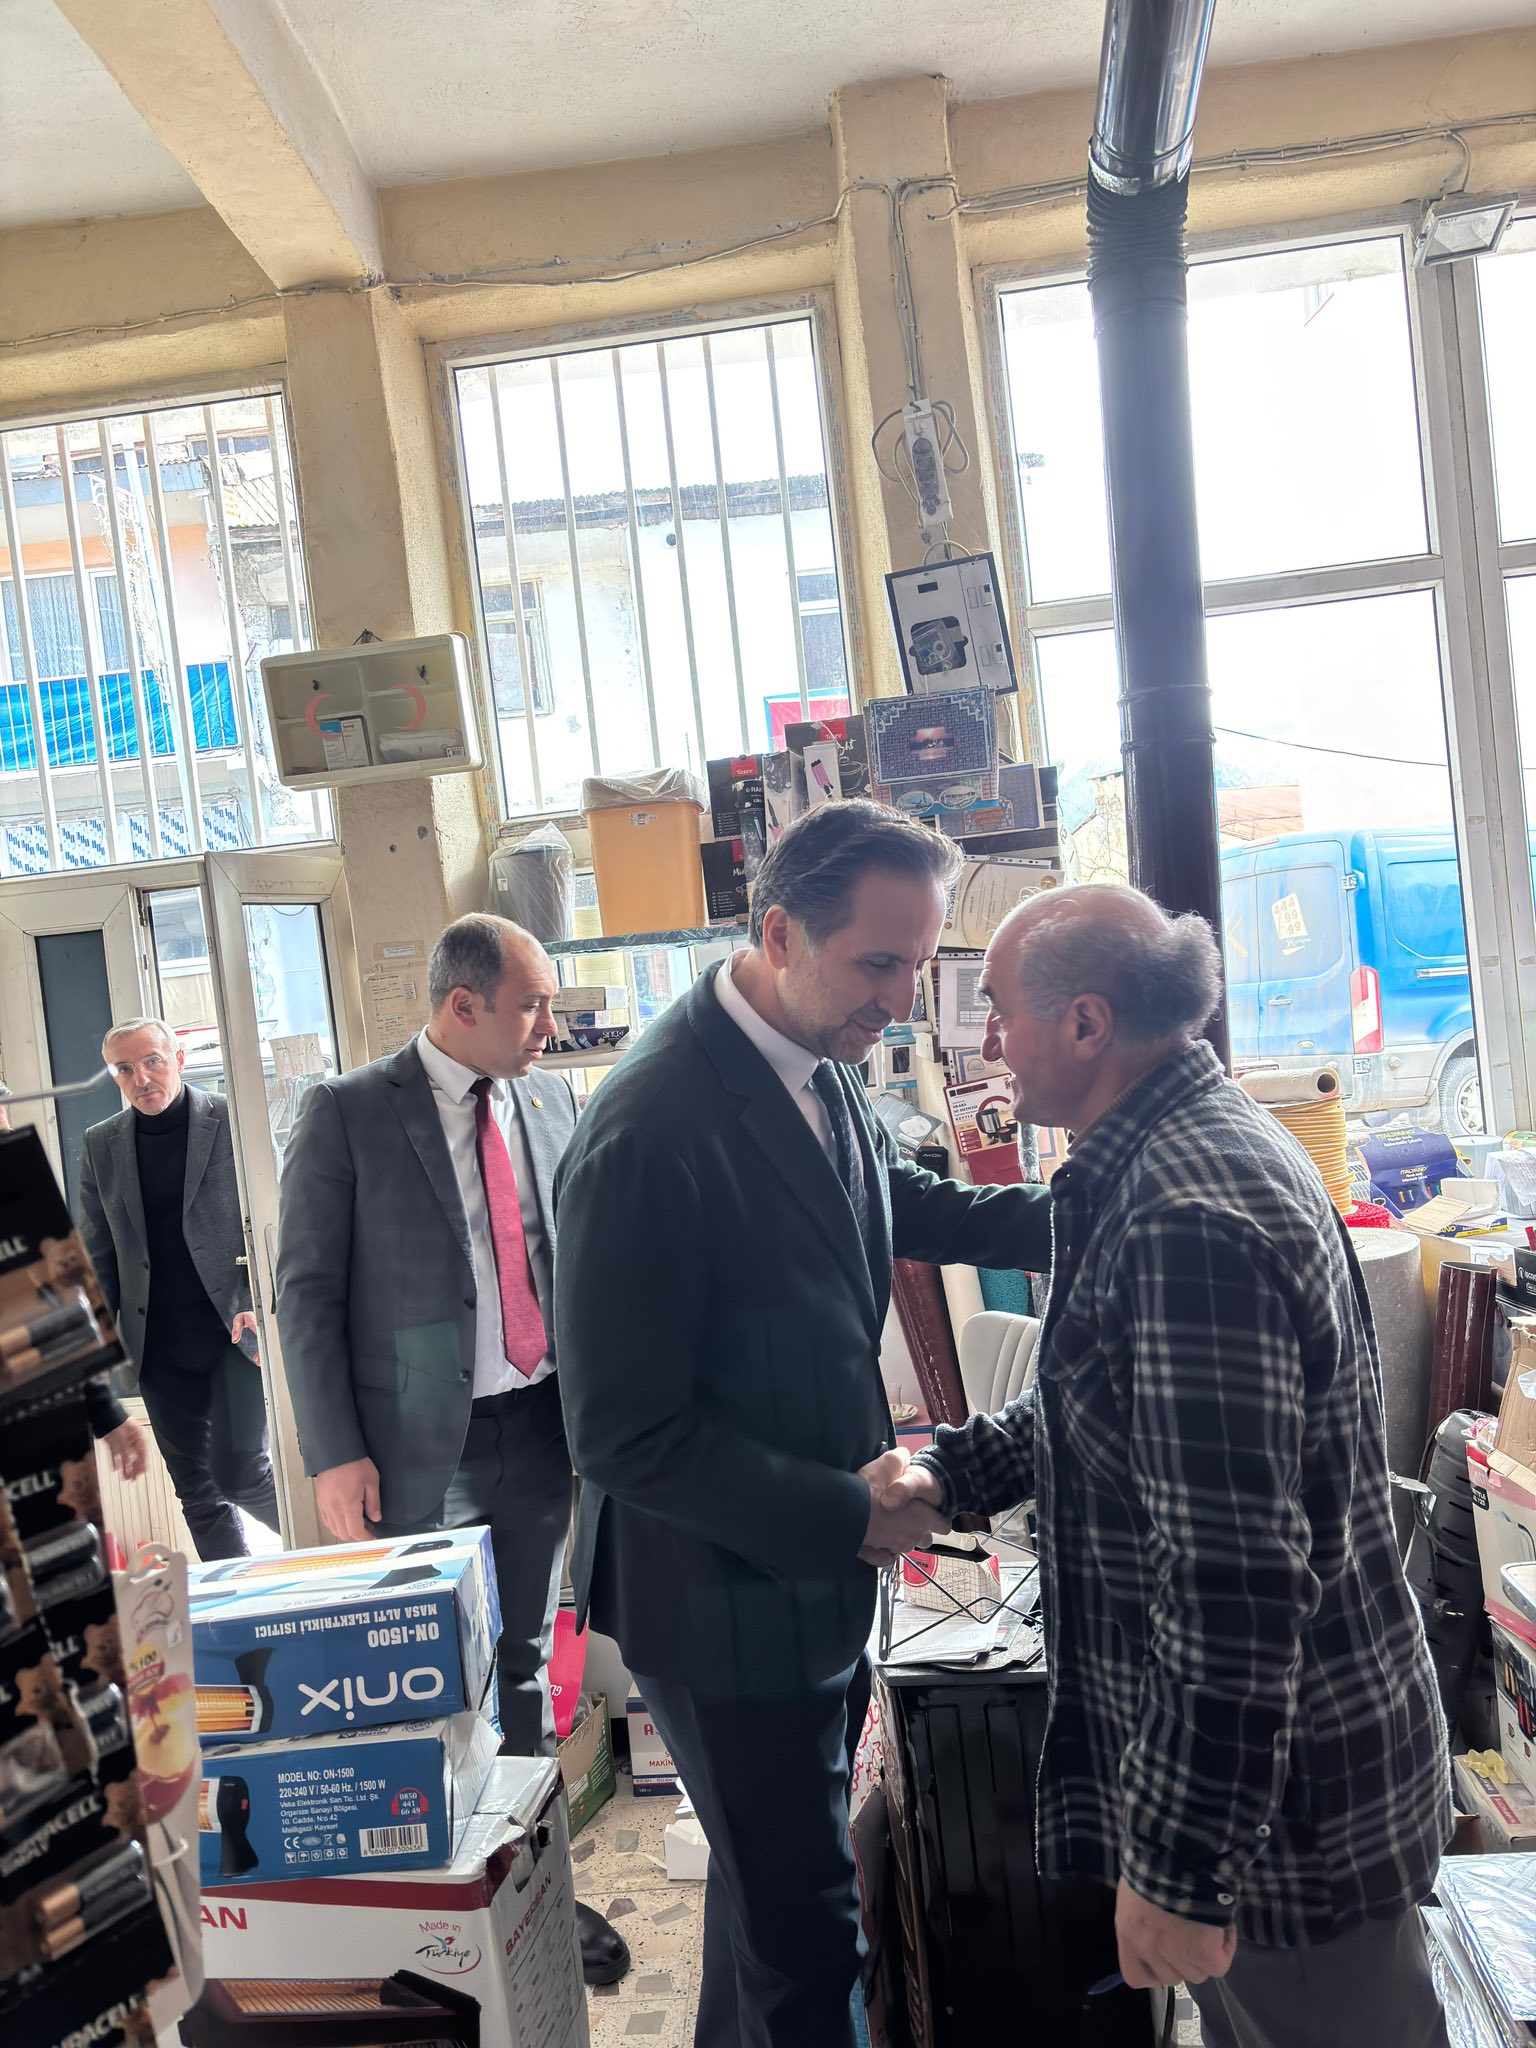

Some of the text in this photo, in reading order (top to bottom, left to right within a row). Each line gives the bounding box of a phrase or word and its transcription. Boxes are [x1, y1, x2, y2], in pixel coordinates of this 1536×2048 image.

[1273, 897, 1295, 915] 444
[1284, 909, 1298, 923] 99
[1287, 921, 1301, 935] 99
[938, 1568, 970, 1581] CAMERA
[255, 1603, 438, 1638] MASA ALTI ELEKTRİKLİ ISITICI
[367, 1622, 440, 1648] ON-1500
[298, 1666, 445, 1721] onix
[278, 1767, 355, 1784] MODEL NO: ON-1500
[279, 1786, 307, 1798] 220-240
[309, 1785, 315, 1795] V
[320, 1784, 340, 1795] 50-60
[341, 1783, 353, 1792] Hz.
[359, 1780, 377, 1791] 1500
[377, 1779, 386, 1789] W
[297, 1798, 328, 1807] Elektronik
[399, 1792, 418, 1800] 0850
[280, 1808, 309, 1817] Organize
[310, 1806, 333, 1815] Sanayi
[314, 1823, 338, 1832] Kayseri
[419, 1920, 461, 1933] Made in
[415, 1944, 470, 1968] Türkiye
